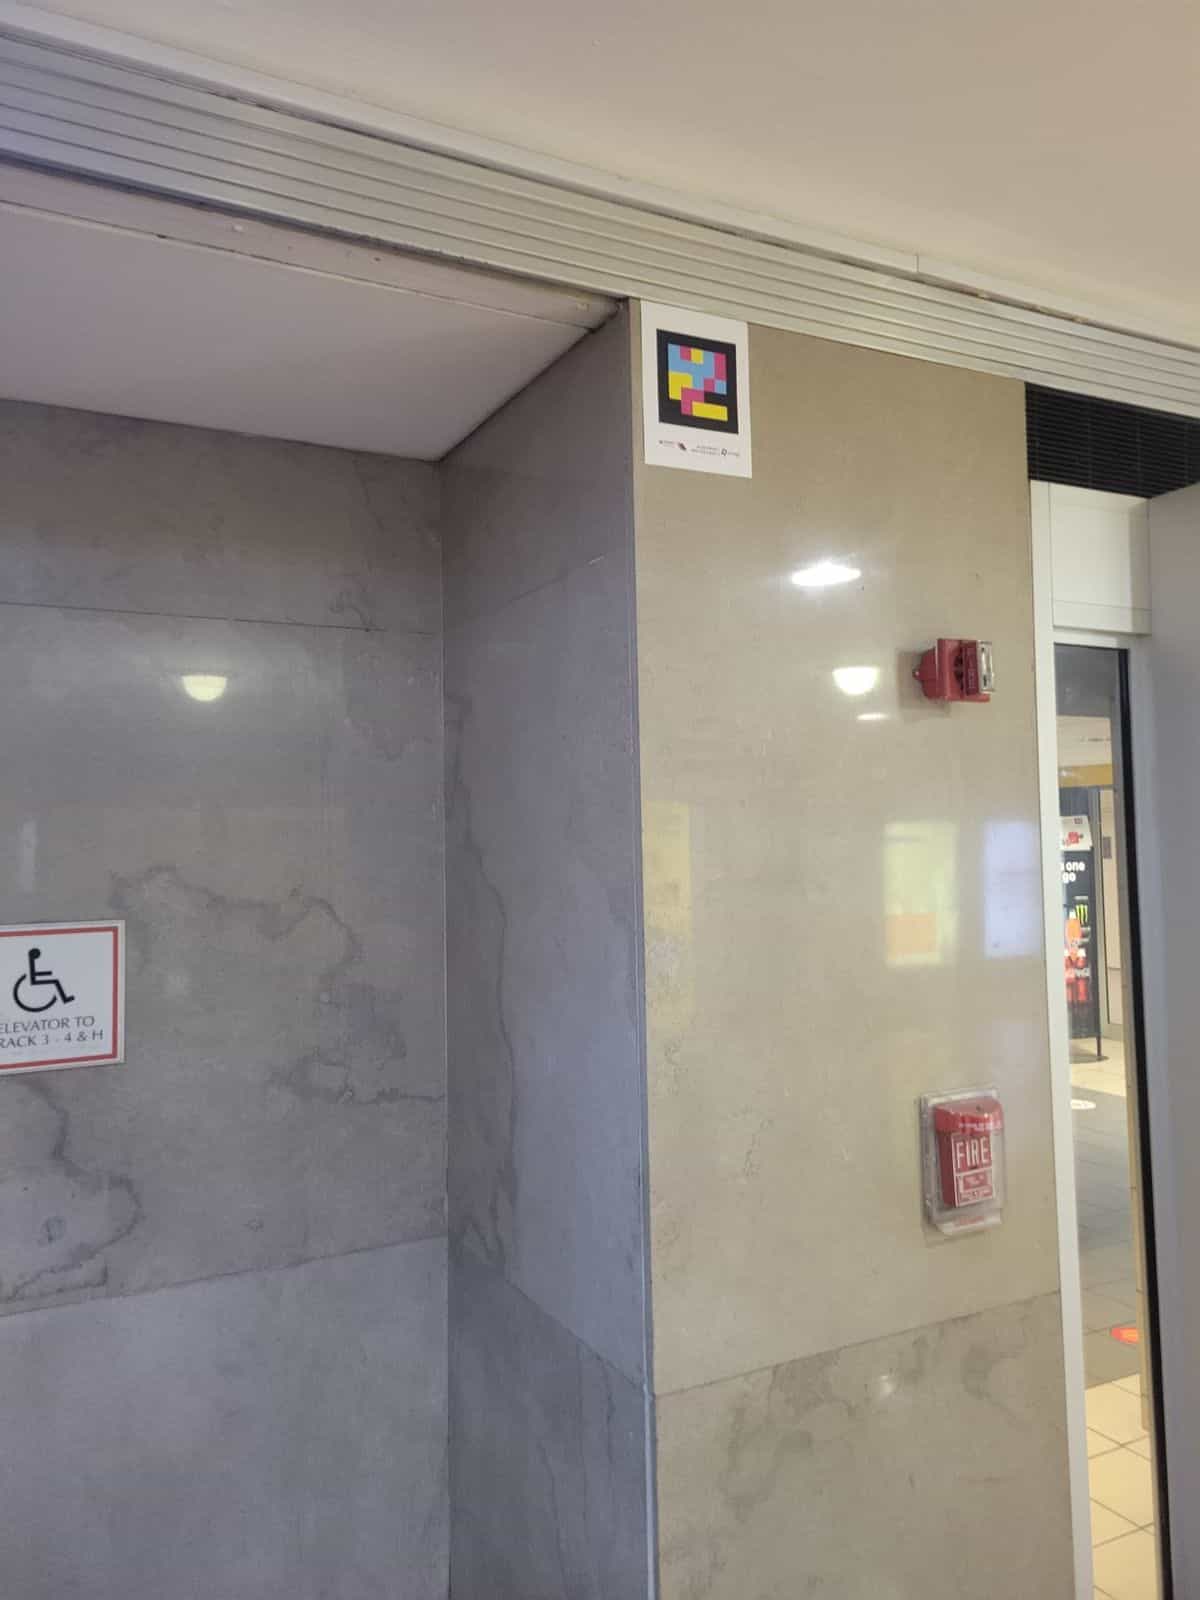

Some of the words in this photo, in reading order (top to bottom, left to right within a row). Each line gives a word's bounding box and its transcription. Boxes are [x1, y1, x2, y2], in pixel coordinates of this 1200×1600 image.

[1065, 862, 1086, 871] one
[74, 1015, 95, 1028] TO
[42, 1034, 49, 1045] 3
[63, 1032, 72, 1042] 4
[76, 1031, 88, 1042] &
[92, 1029, 104, 1041] H
[956, 1136, 989, 1169] FIRE
